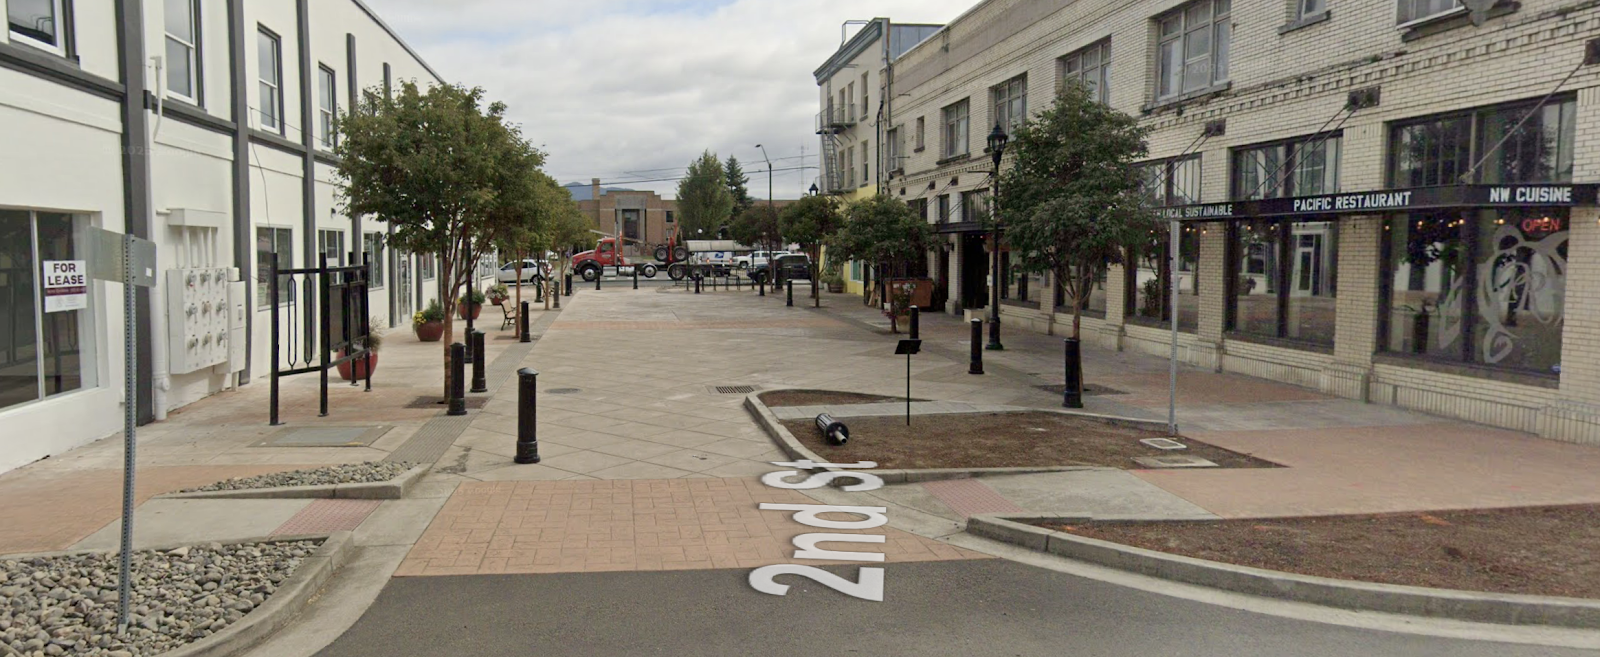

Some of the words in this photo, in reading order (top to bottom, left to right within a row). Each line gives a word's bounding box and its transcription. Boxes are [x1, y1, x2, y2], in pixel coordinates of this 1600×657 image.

[1293, 197, 1332, 212] PACIFIC
[1335, 191, 1412, 210] RESTAURANT
[1489, 187, 1511, 203] NW
[1515, 187, 1573, 202] CUISINE
[1162, 208, 1183, 219] LOCAL
[1185, 204, 1233, 217] SUSTAINABLE
[1522, 218, 1560, 232] OPEN
[53, 263, 76, 273] FOR
[48, 274, 84, 286] LEASE
